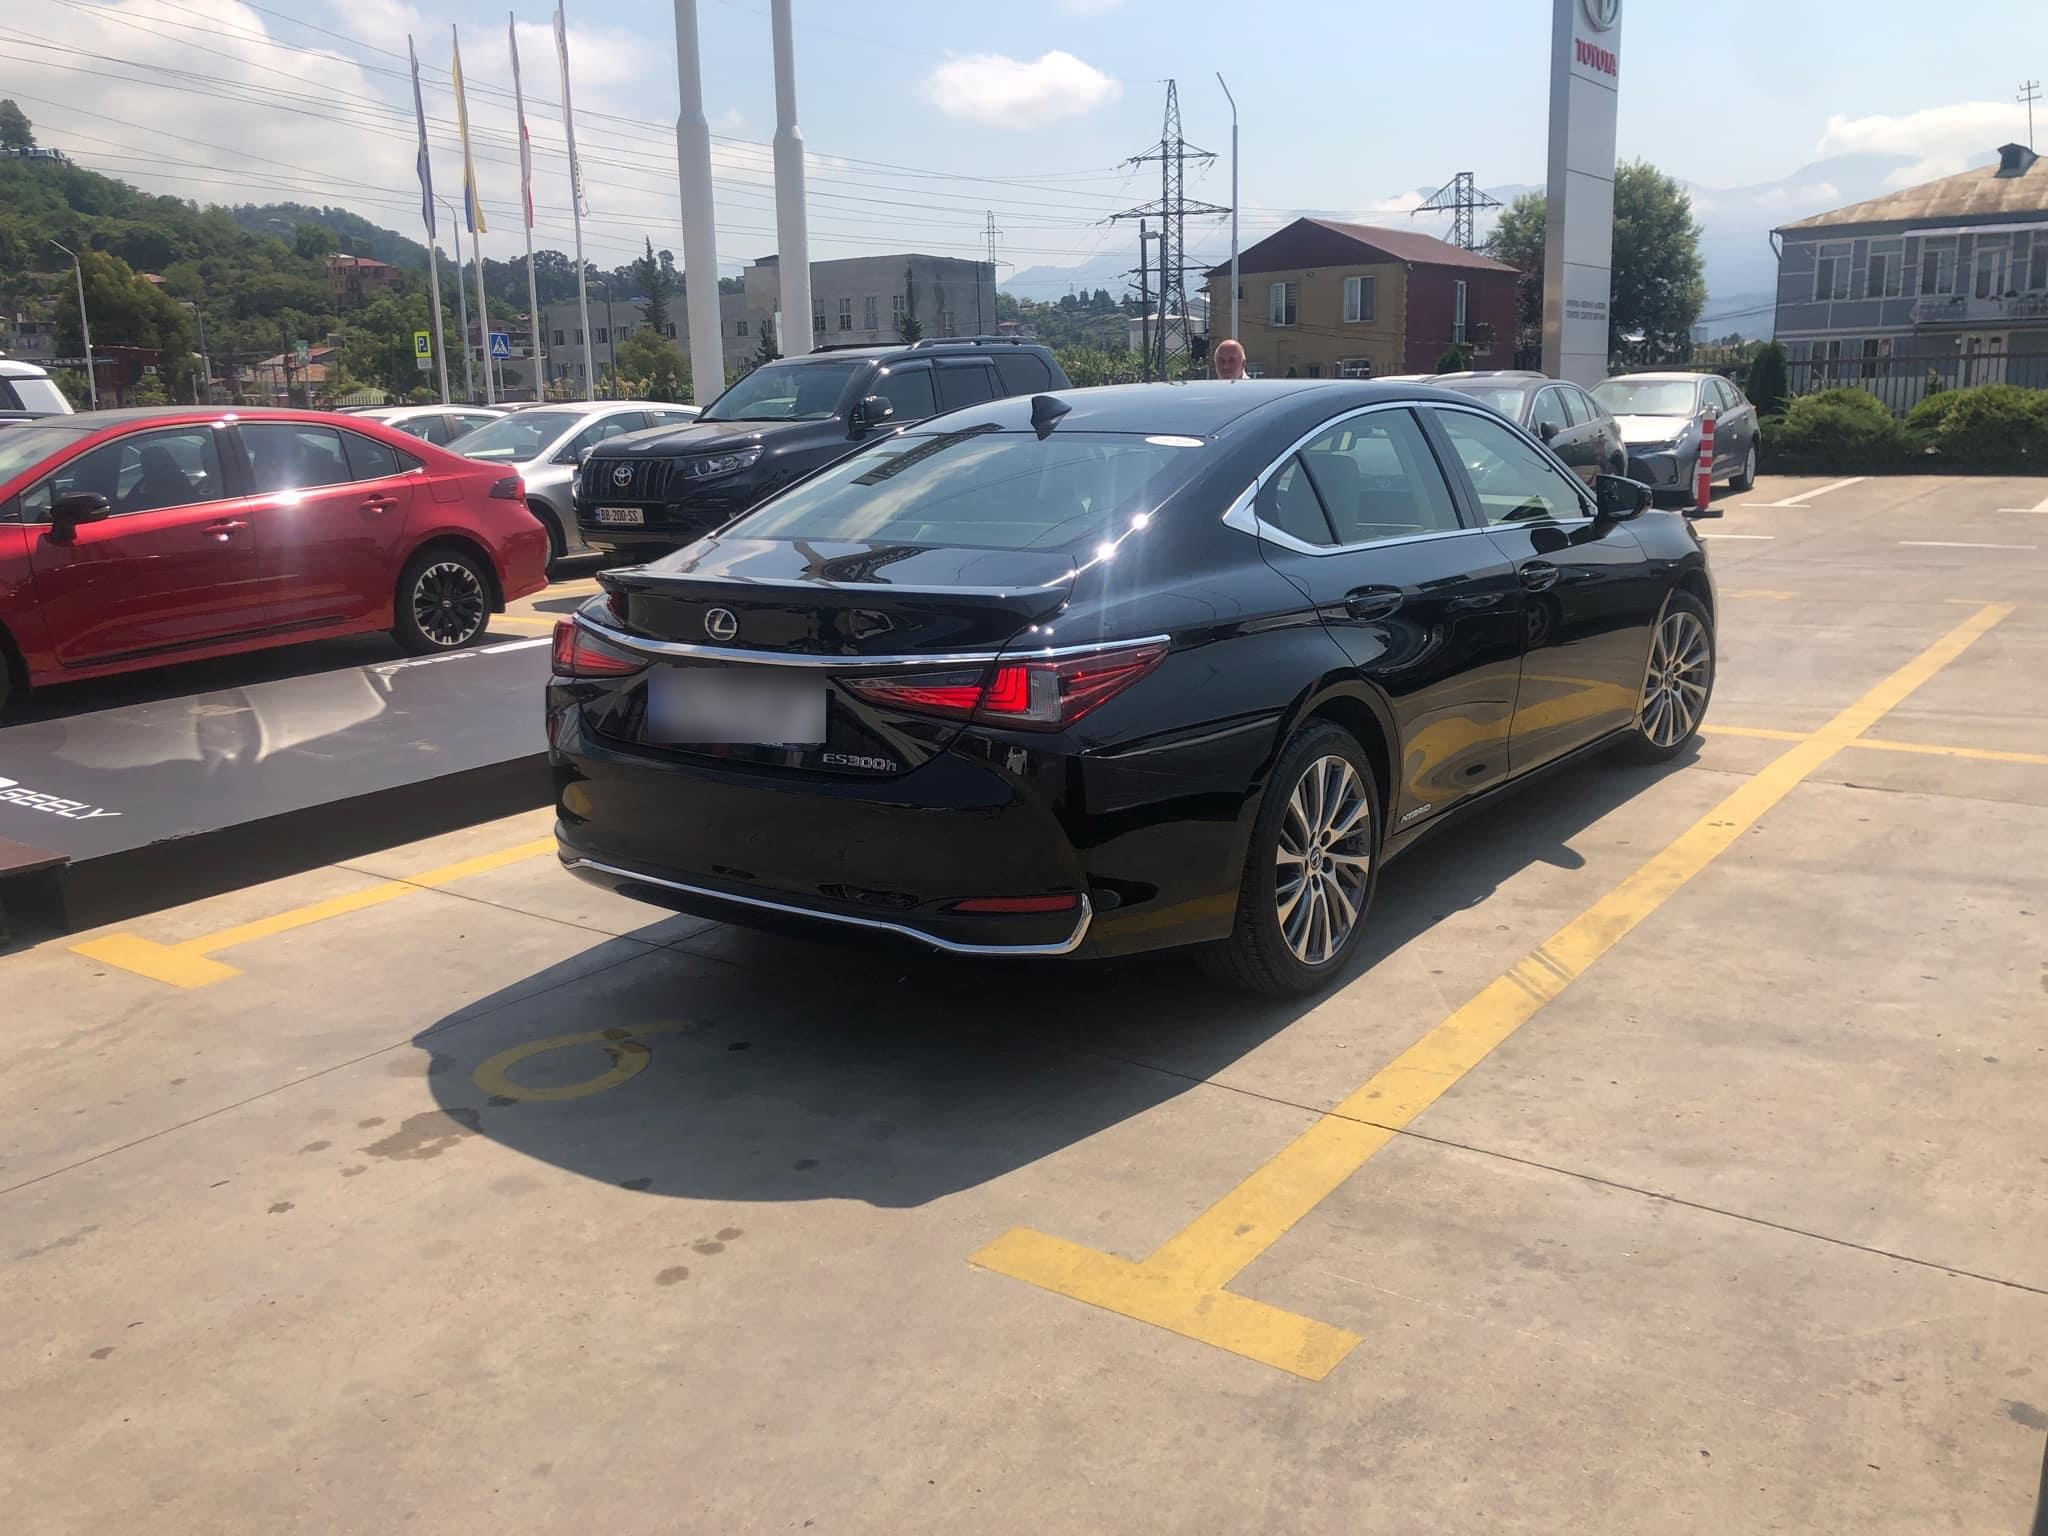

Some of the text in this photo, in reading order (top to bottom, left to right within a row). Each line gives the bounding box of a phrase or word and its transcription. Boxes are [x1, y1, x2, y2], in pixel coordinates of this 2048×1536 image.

[1575, 38, 1617, 77] TOYOTA
[823, 753, 897, 771] ES300h
[0, 788, 123, 819] GEELY
